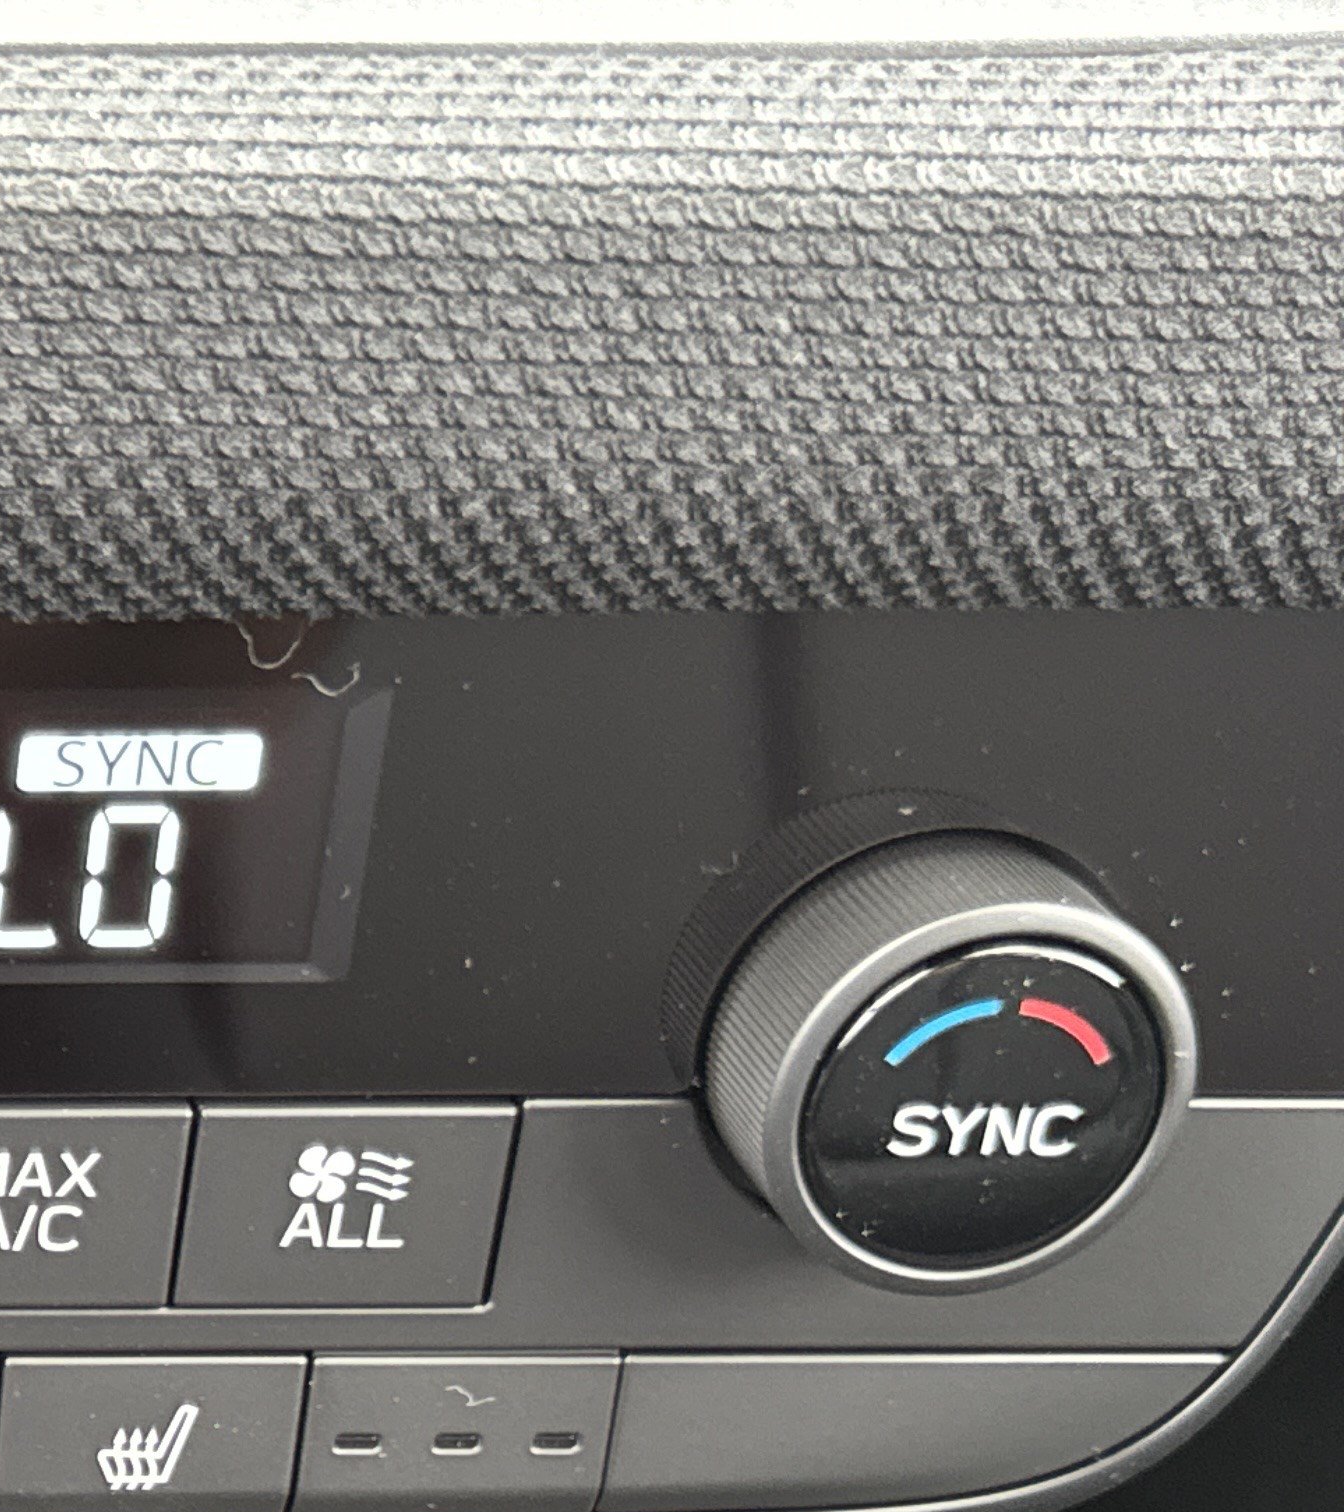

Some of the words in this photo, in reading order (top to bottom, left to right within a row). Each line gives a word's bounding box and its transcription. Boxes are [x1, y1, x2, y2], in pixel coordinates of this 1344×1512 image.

[52, 739, 224, 788] SYNC
[885, 1103, 1085, 1158] SYNC
[278, 1202, 406, 1249] ALL
